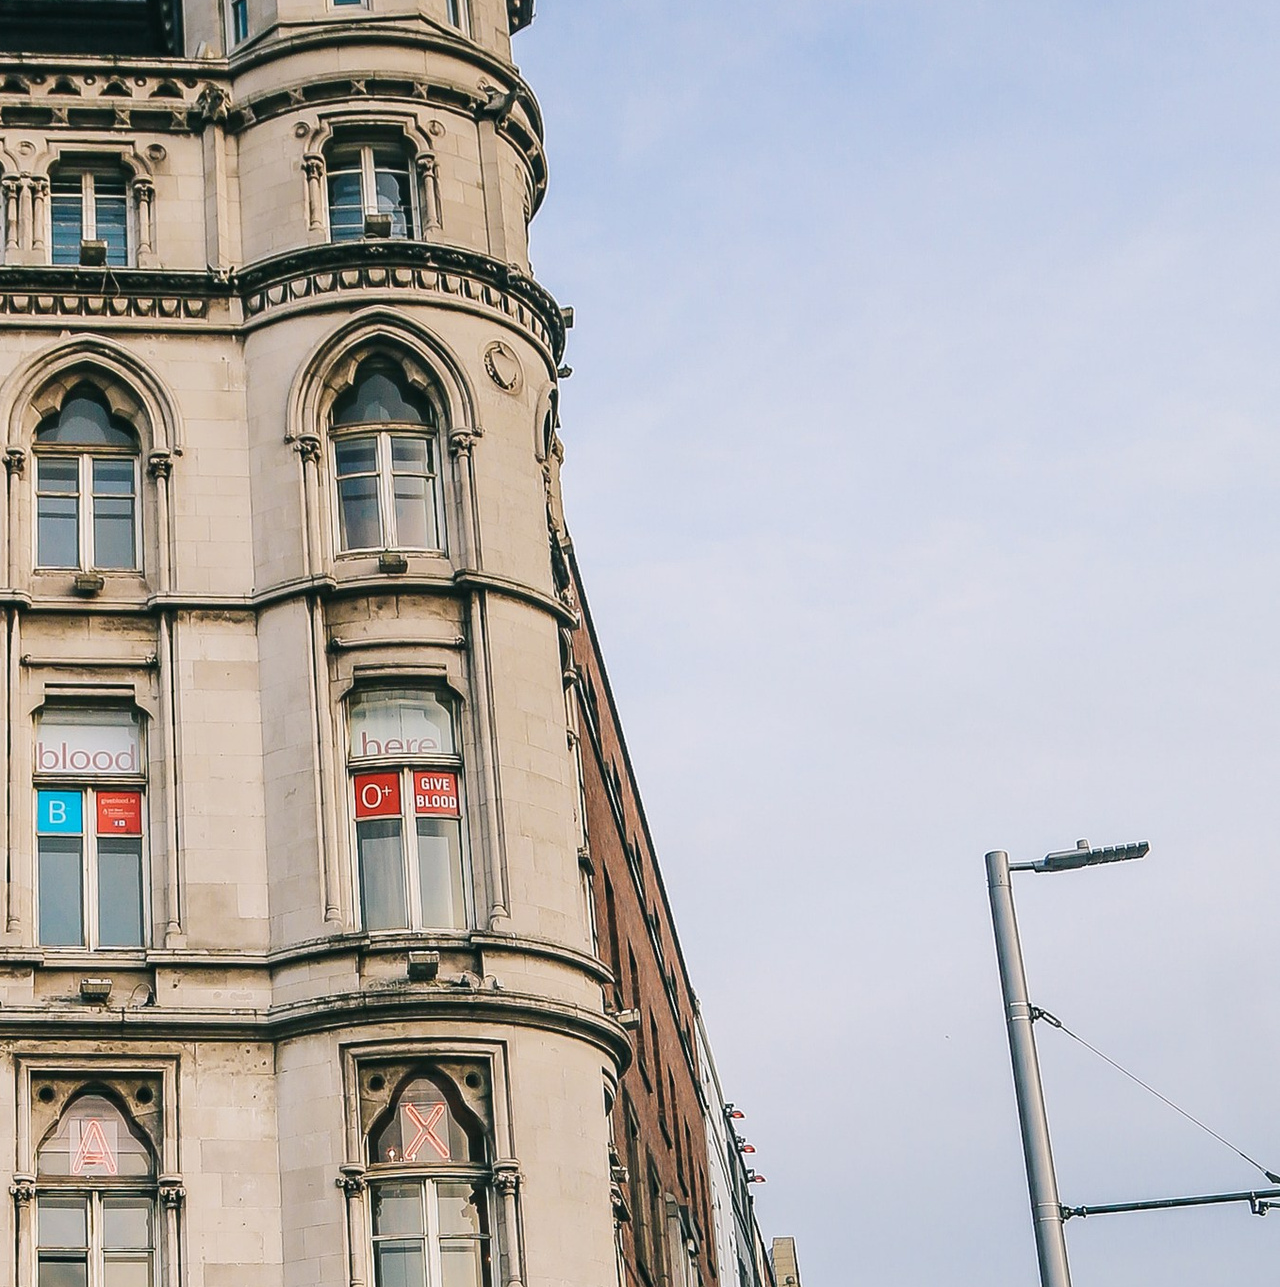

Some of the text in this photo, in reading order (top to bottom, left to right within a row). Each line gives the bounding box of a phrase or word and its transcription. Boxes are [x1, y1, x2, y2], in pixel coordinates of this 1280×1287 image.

[38, 741, 136, 772] blood
[361, 731, 438, 756] here
[420, 777, 451, 791] GIVE
[416, 794, 457, 809] BLOOD
[405, 1104, 450, 1160] X
[72, 1120, 117, 1174] A
